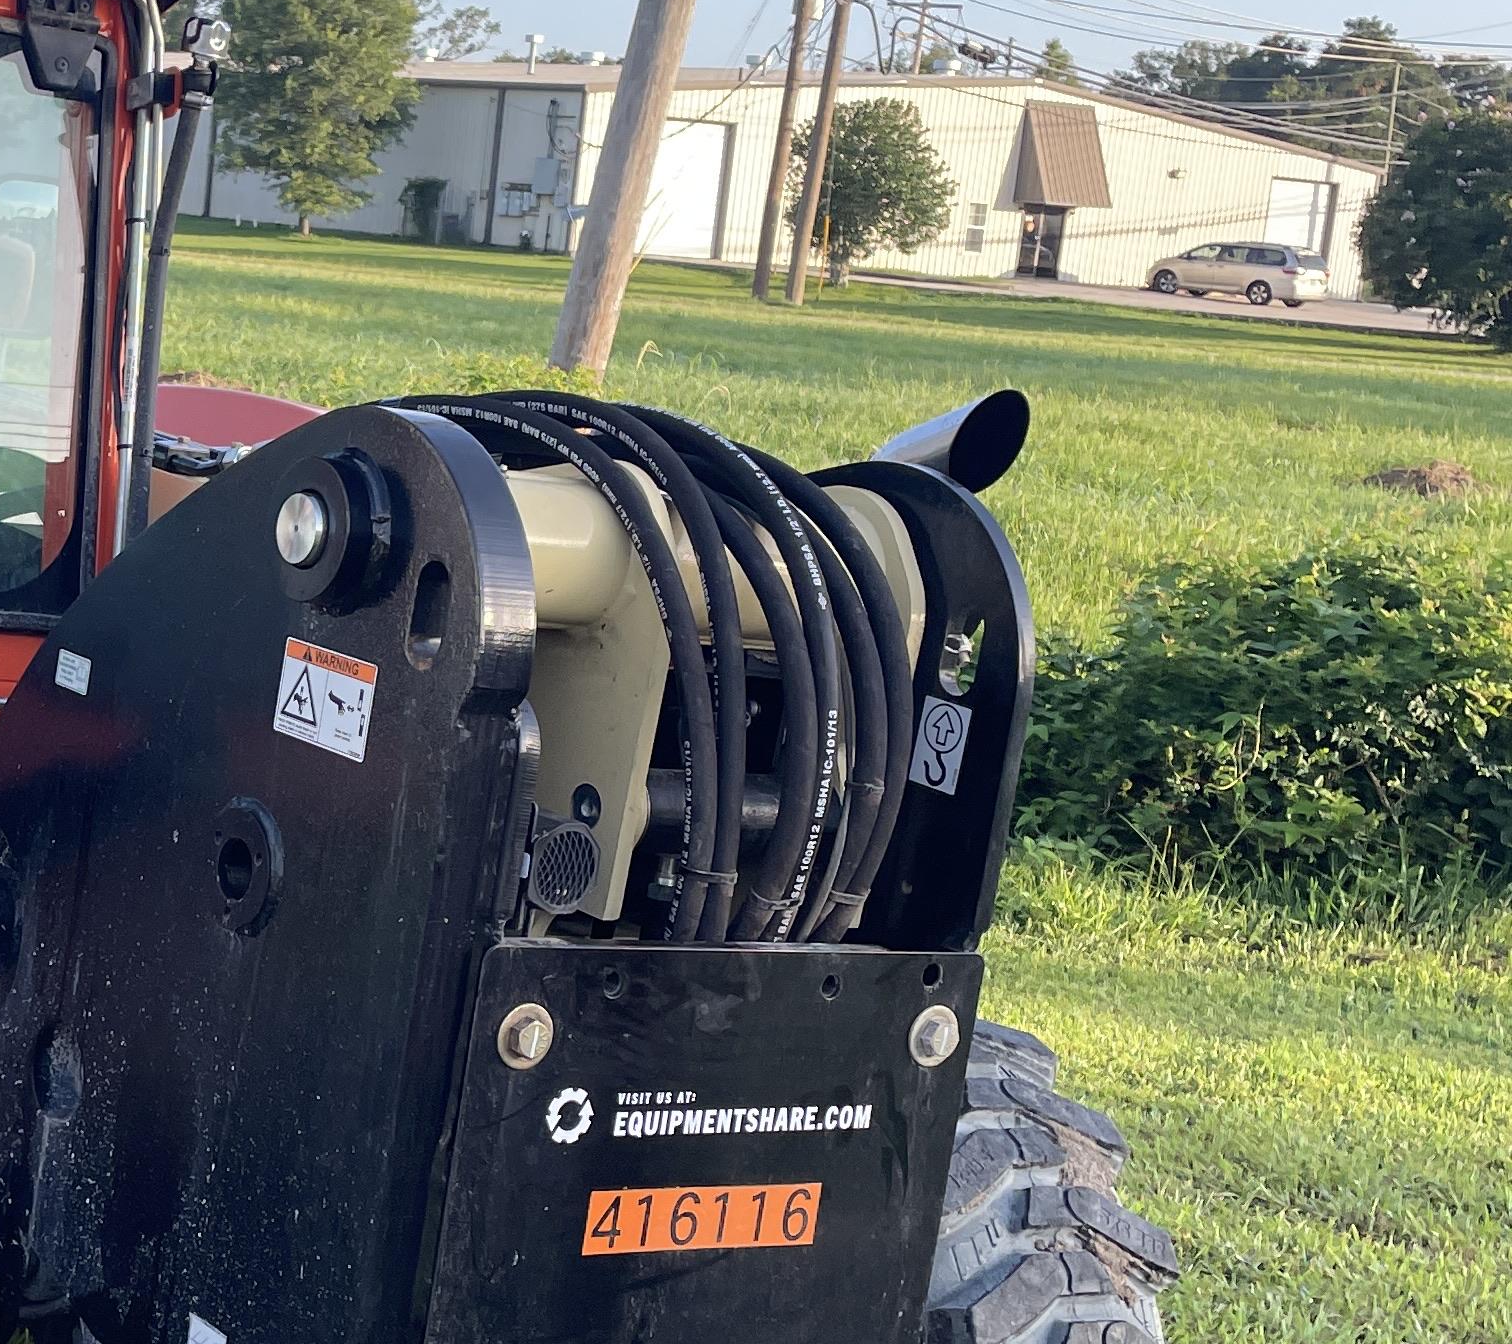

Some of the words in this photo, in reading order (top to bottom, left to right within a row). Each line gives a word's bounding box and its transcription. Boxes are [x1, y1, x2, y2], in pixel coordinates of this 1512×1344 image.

[315, 650, 360, 676] WARNING
[800, 824, 821, 872] 100R12
[814, 777, 832, 820] MSHA
[617, 1092, 652, 1105] VISIT
[656, 1091, 673, 1104] US
[676, 1091, 697, 1104] AT:
[613, 1104, 874, 1138] EQUIPMENTSHARE.COM
[590, 1188, 813, 1249] 416116
